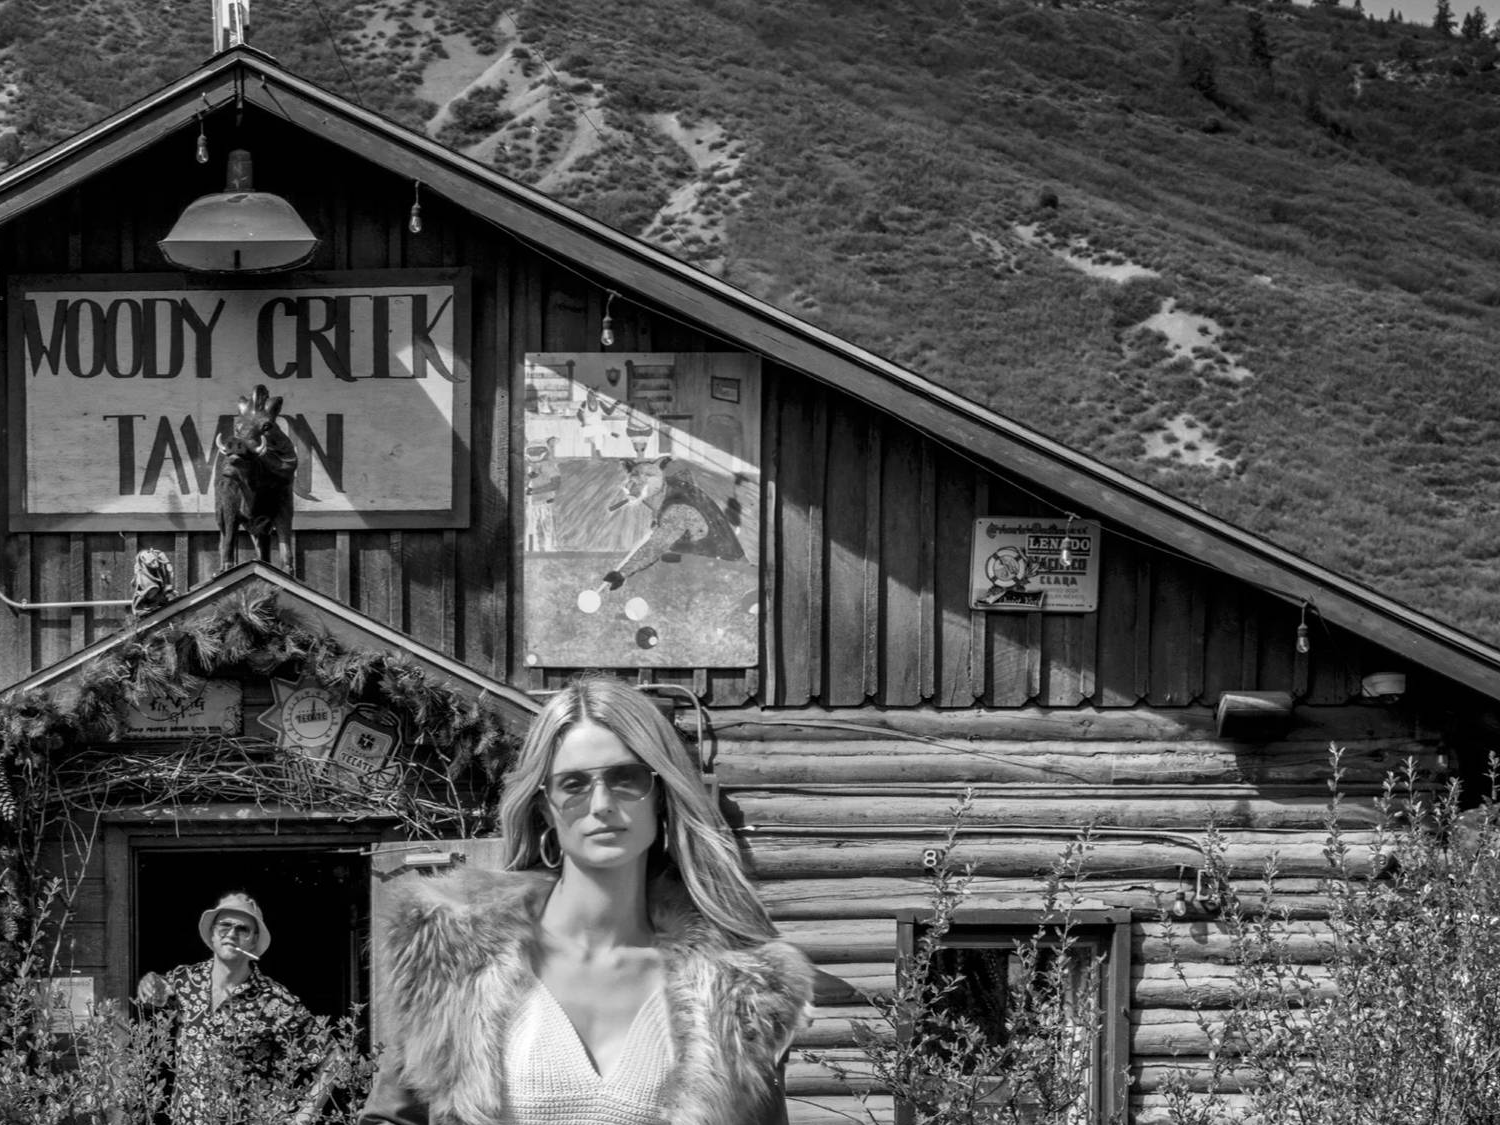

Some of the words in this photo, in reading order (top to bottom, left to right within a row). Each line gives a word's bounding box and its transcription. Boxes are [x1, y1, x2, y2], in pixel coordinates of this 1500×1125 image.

[24, 298, 225, 379] WOODY
[257, 294, 466, 383] CREEK
[103, 413, 346, 502] TAVN
[1028, 538, 1090, 550] LENDO
[341, 752, 374, 773] TECATE
[924, 850, 937, 867] 8
